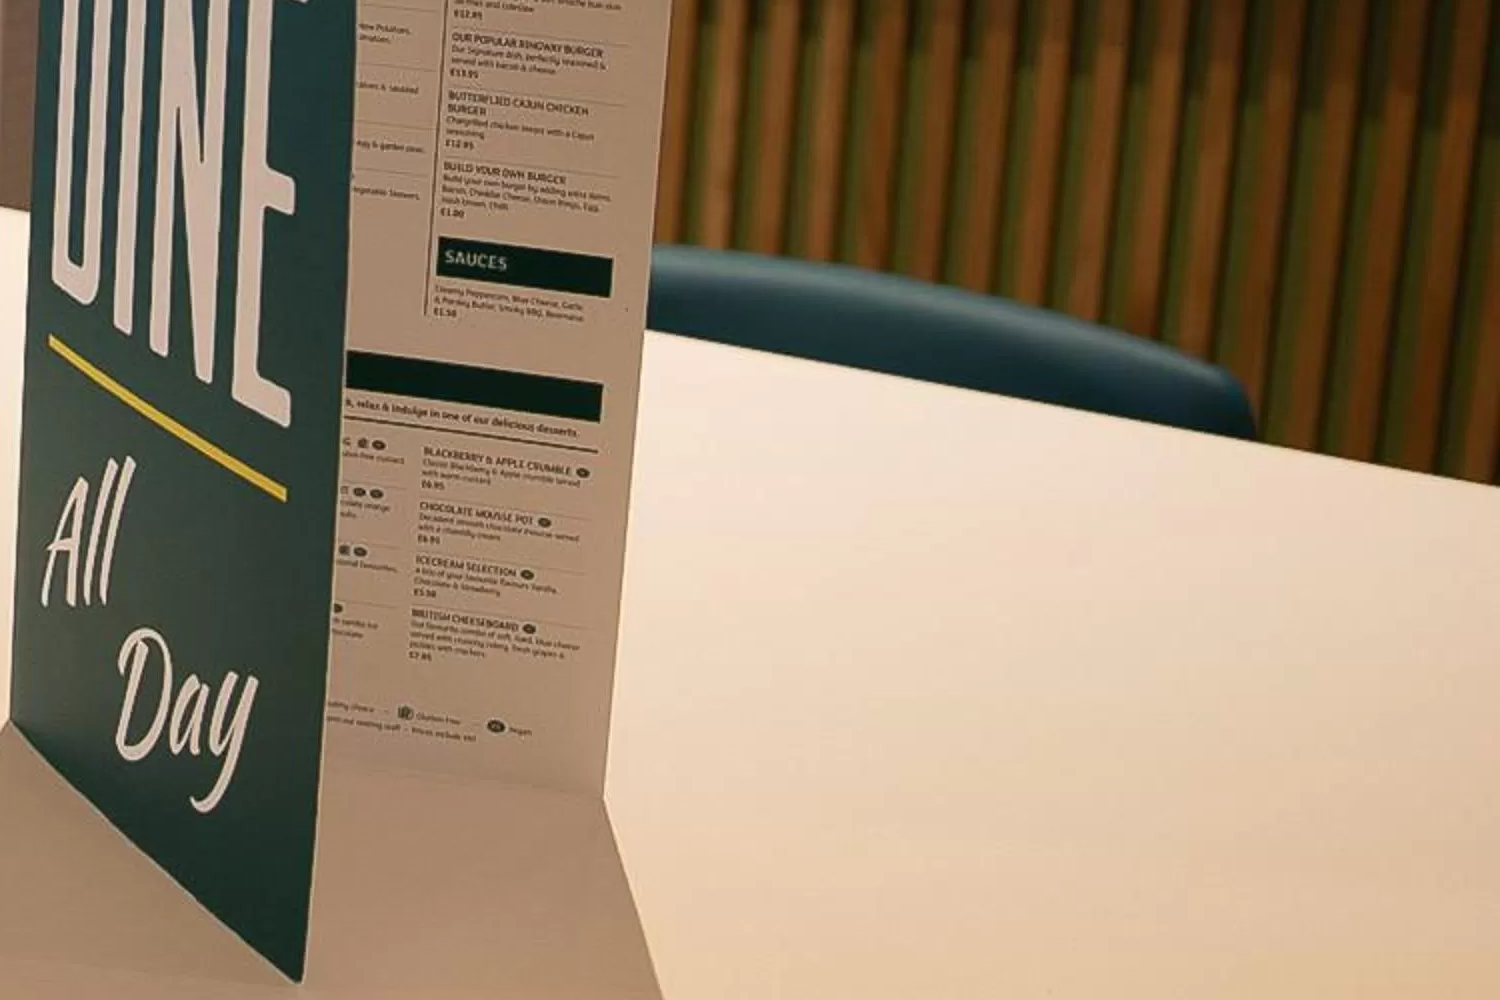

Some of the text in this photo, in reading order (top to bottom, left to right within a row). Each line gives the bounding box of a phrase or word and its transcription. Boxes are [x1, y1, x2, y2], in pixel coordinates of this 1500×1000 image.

[451, 32, 473, 44] OUR
[474, 35, 517, 48] POPULAR
[564, 45, 604, 58] BURGER
[447, 103, 486, 117] BURGER
[512, 97, 544, 111] CAJUN
[545, 101, 589, 116] CHICKEN
[442, 161, 566, 185] BUILD YOUR OWN BURGER
[443, 248, 508, 271] SAUCES
[356, 397, 380, 409] relax
[391, 402, 427, 418] indulge
[441, 411, 459, 420] one
[473, 415, 488, 424] our
[490, 416, 534, 431] delicious
[423, 445, 484, 464] BLACKBERRY
[494, 455, 523, 469] APPLE
[526, 460, 571, 476] CRUMBLE
[418, 499, 532, 526] CHOCOLATE MOUSSE POT
[41, 455, 137, 607] All
[465, 561, 517, 579] SELECTION
[411, 607, 520, 633] BRITISH CHEESEBOARD
[115, 627, 258, 813] Day
